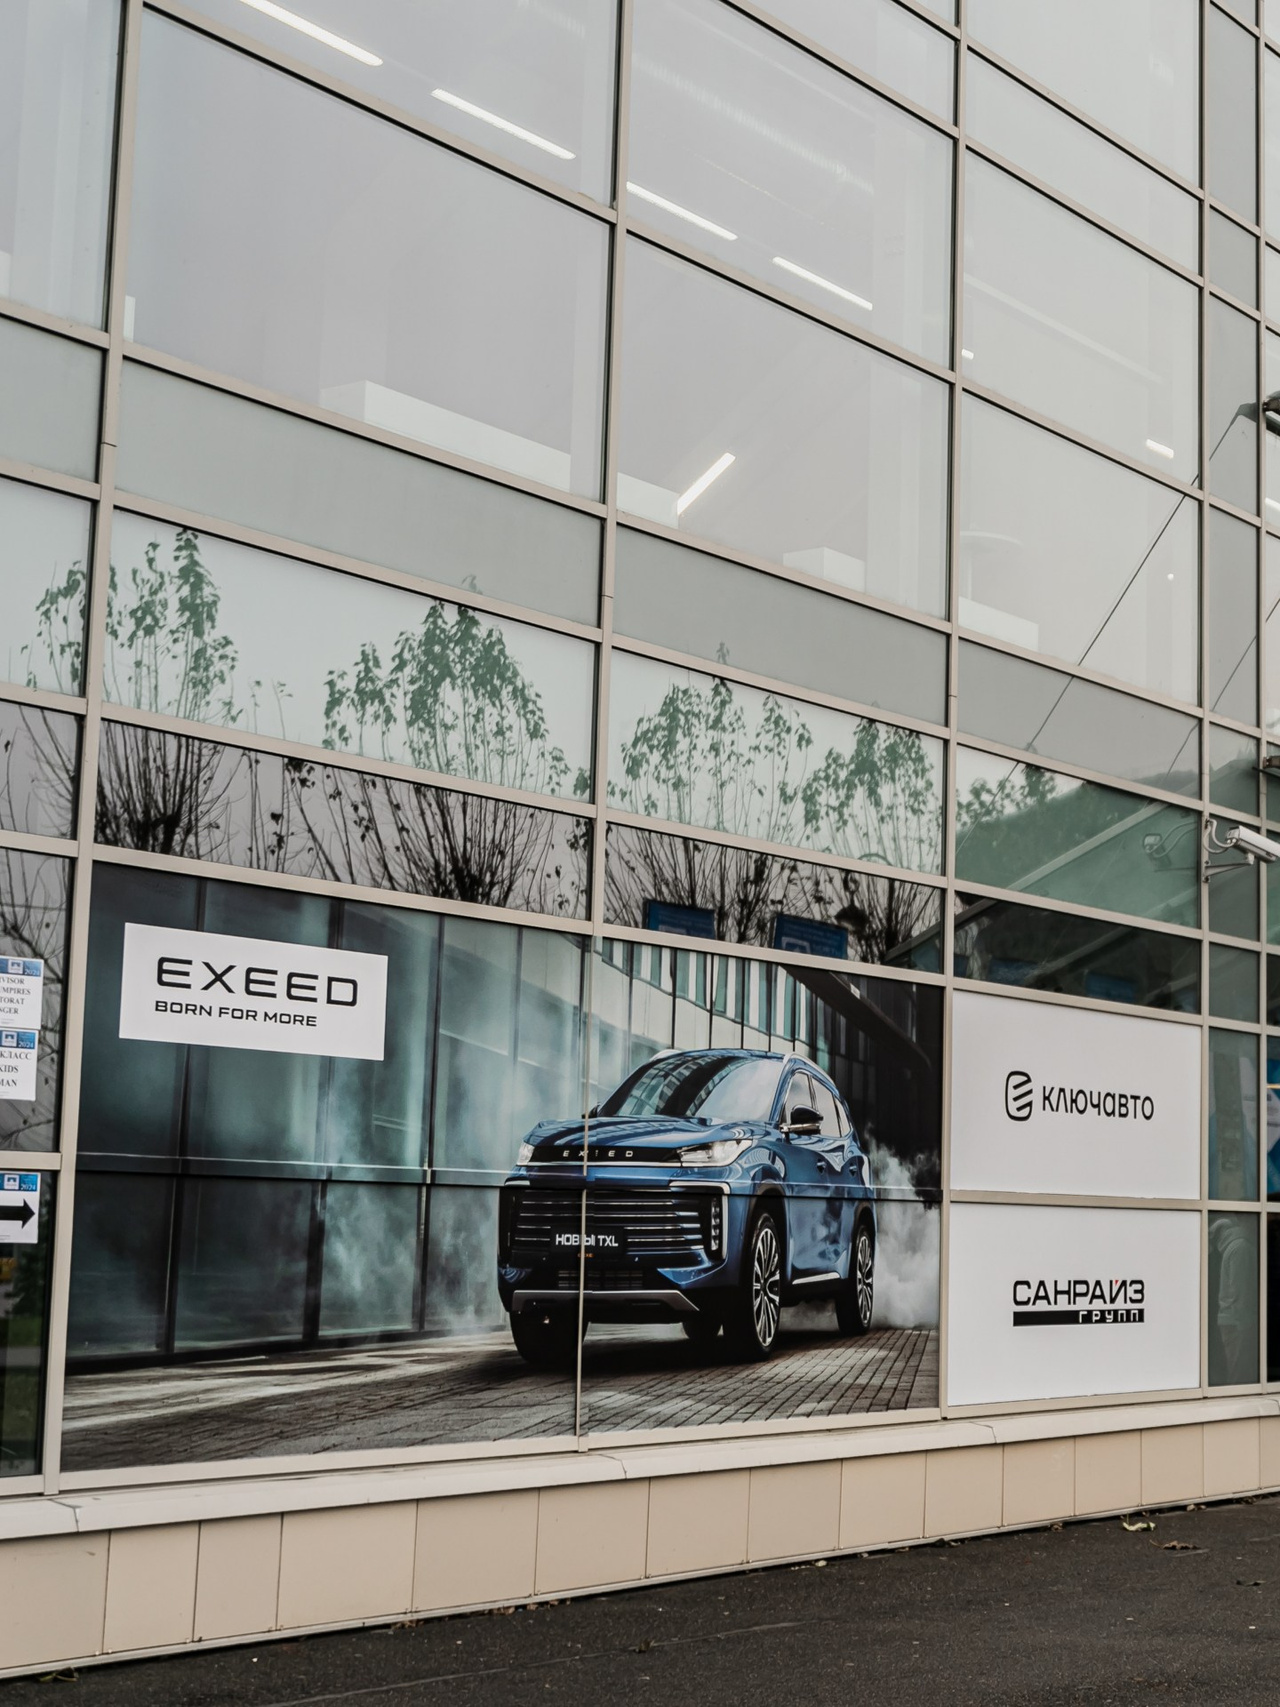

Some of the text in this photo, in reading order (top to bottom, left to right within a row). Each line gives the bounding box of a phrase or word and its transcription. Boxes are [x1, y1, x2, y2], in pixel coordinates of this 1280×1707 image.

[157, 956, 358, 1007] EXEED
[155, 1000, 318, 1027] BORN FOR MORE
[20, 1183, 36, 1191] 2024
[597, 1235, 619, 1247] TXL
[1012, 1279, 1145, 1306] САНРАЙЗ
[1078, 1309, 1139, 1324] ГРУПП
